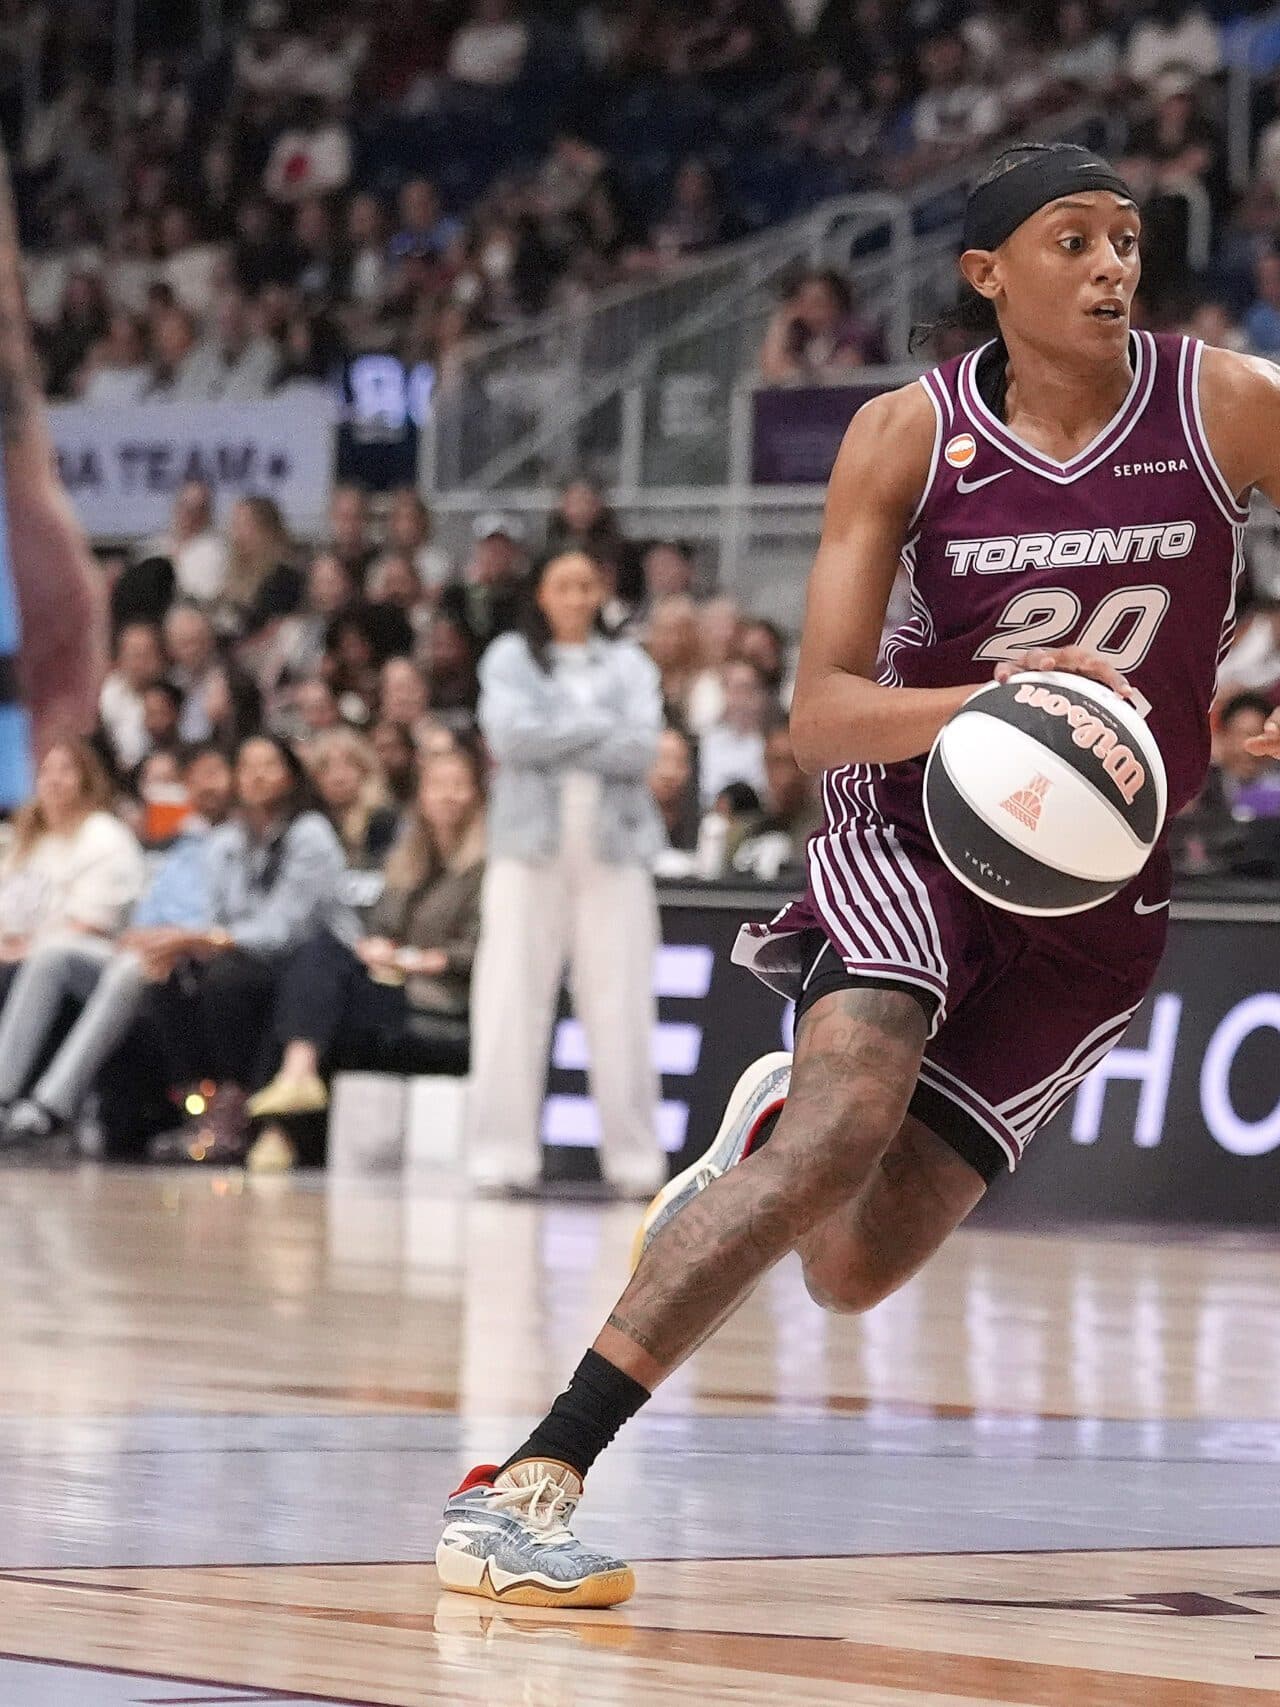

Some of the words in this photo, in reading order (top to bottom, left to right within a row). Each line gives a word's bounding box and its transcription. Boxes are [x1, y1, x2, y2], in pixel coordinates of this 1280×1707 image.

[1113, 459, 1189, 477] SEPHORA
[946, 520, 1197, 577] TORONTO
[971, 585, 1171, 674] 20
[1014, 684, 1146, 806] Wilson
